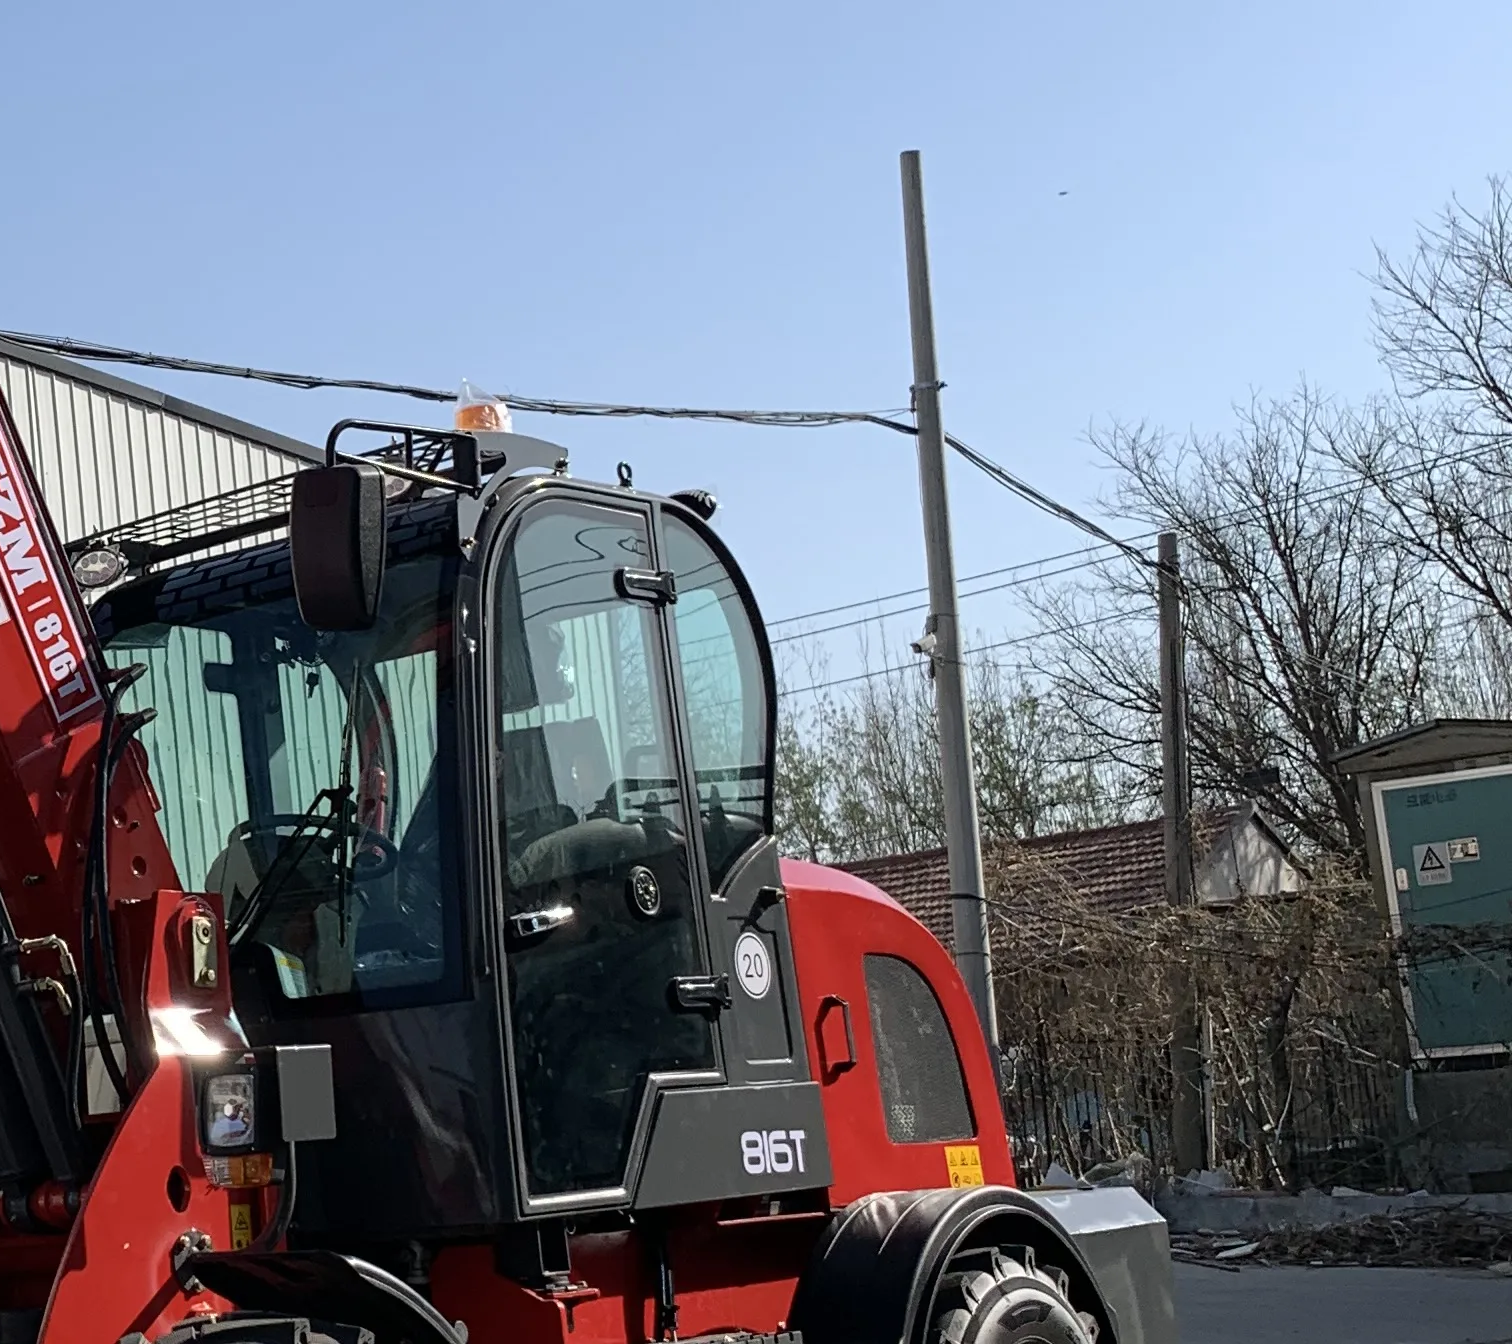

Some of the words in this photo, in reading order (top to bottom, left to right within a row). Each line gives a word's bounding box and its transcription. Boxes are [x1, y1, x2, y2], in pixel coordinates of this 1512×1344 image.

[33, 612, 86, 698] 816T
[742, 953, 763, 978] 20
[741, 1129, 805, 1174] 816T
